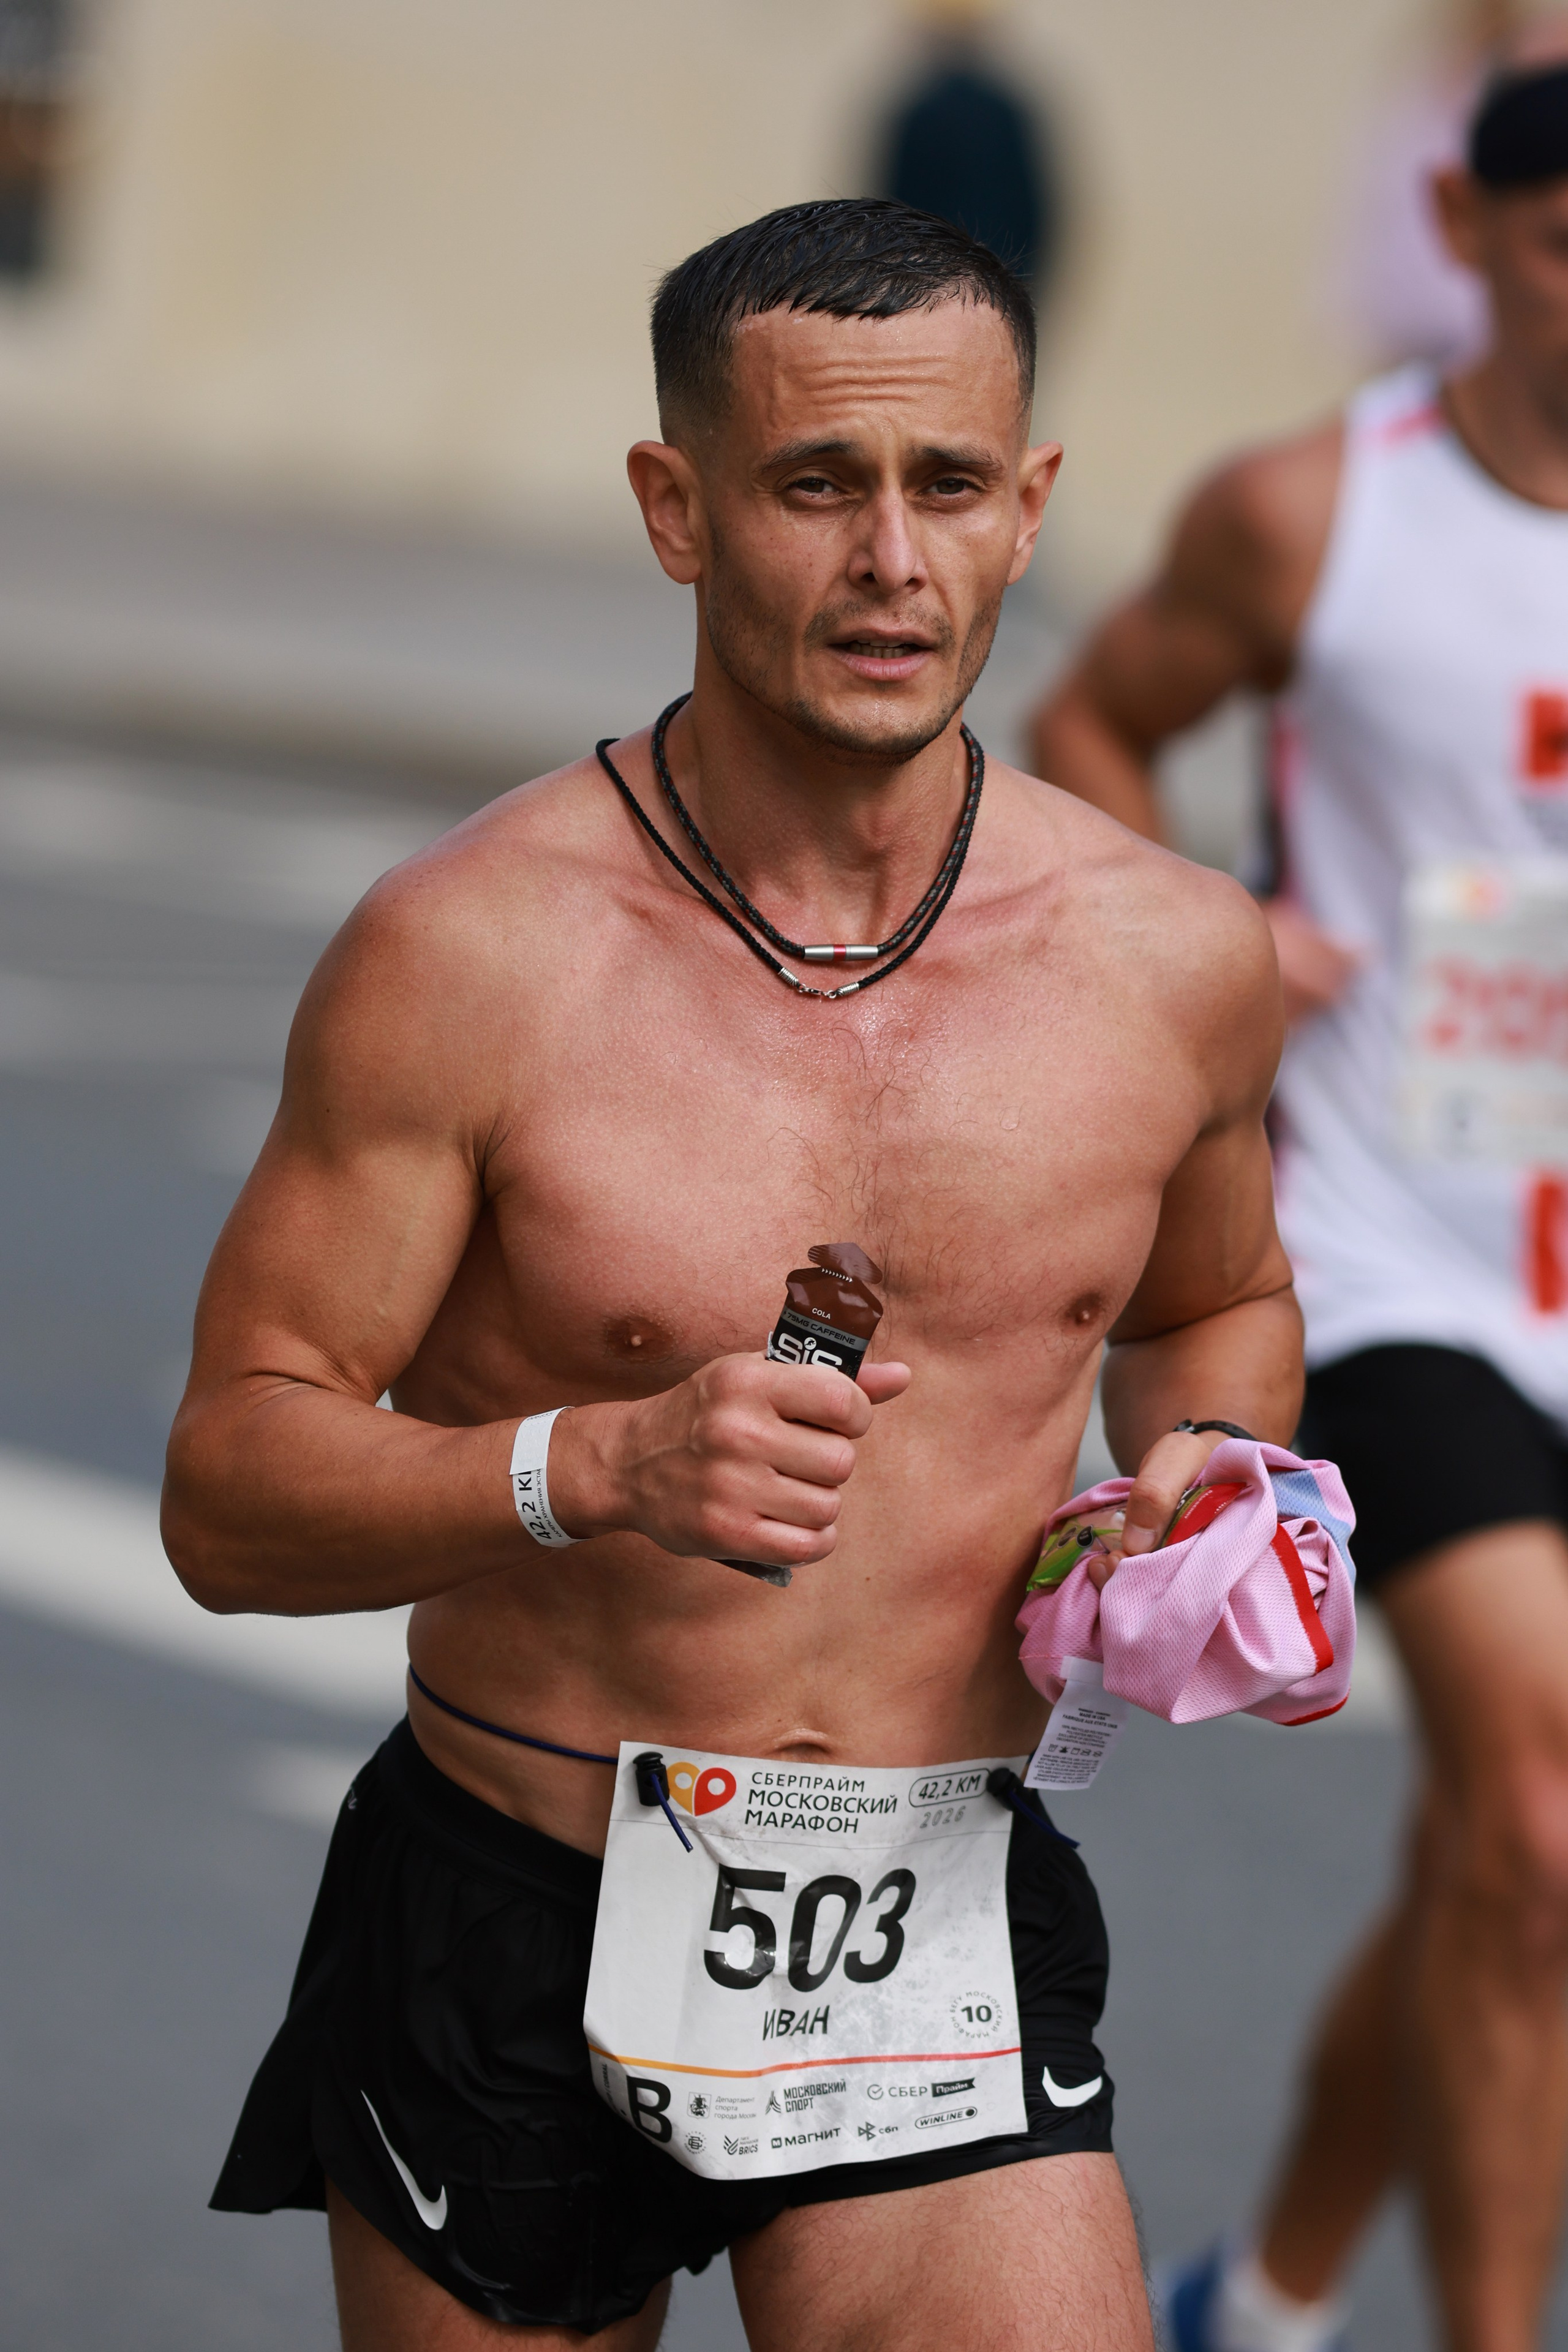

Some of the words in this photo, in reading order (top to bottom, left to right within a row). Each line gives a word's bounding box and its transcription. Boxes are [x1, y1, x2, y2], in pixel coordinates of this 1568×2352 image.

[812, 1308, 831, 1320] COLA
[788, 1312, 810, 1327] 75MG
[810, 1323, 856, 1345] CAFFEINE
[518, 1471, 532, 1491] К
[537, 1487, 548, 1518] ХРАНЕНИЯ
[521, 1501, 552, 1539] 42,2
[546, 1519, 563, 1538] КАМЕРЫ
[752, 1771, 865, 1793] СБЕРПРАЙМ
[918, 1779, 952, 1800] 42,2
[748, 1789, 897, 1814] МОСКОВСКИЙ
[744, 1809, 859, 1834] МАРАФОН
[920, 1805, 966, 1829] 2026
[704, 1863, 916, 1992] 503
[960, 2005, 992, 2022] 10
[966, 1991, 1002, 2032] МОСКОВСКИЙ
[763, 2005, 830, 2041] ИВАН
[951, 2016, 990, 2038] МАРАФОН
[783, 2079, 846, 2100] МОСКОВСКИЙ
[888, 2086, 927, 2097] СБЕР
[936, 2082, 968, 2094] Прайм
[785, 2097, 813, 2113] СПОРТ
[919, 2111, 963, 2127] WINLINE
[739, 2144, 758, 2155] BRICS
